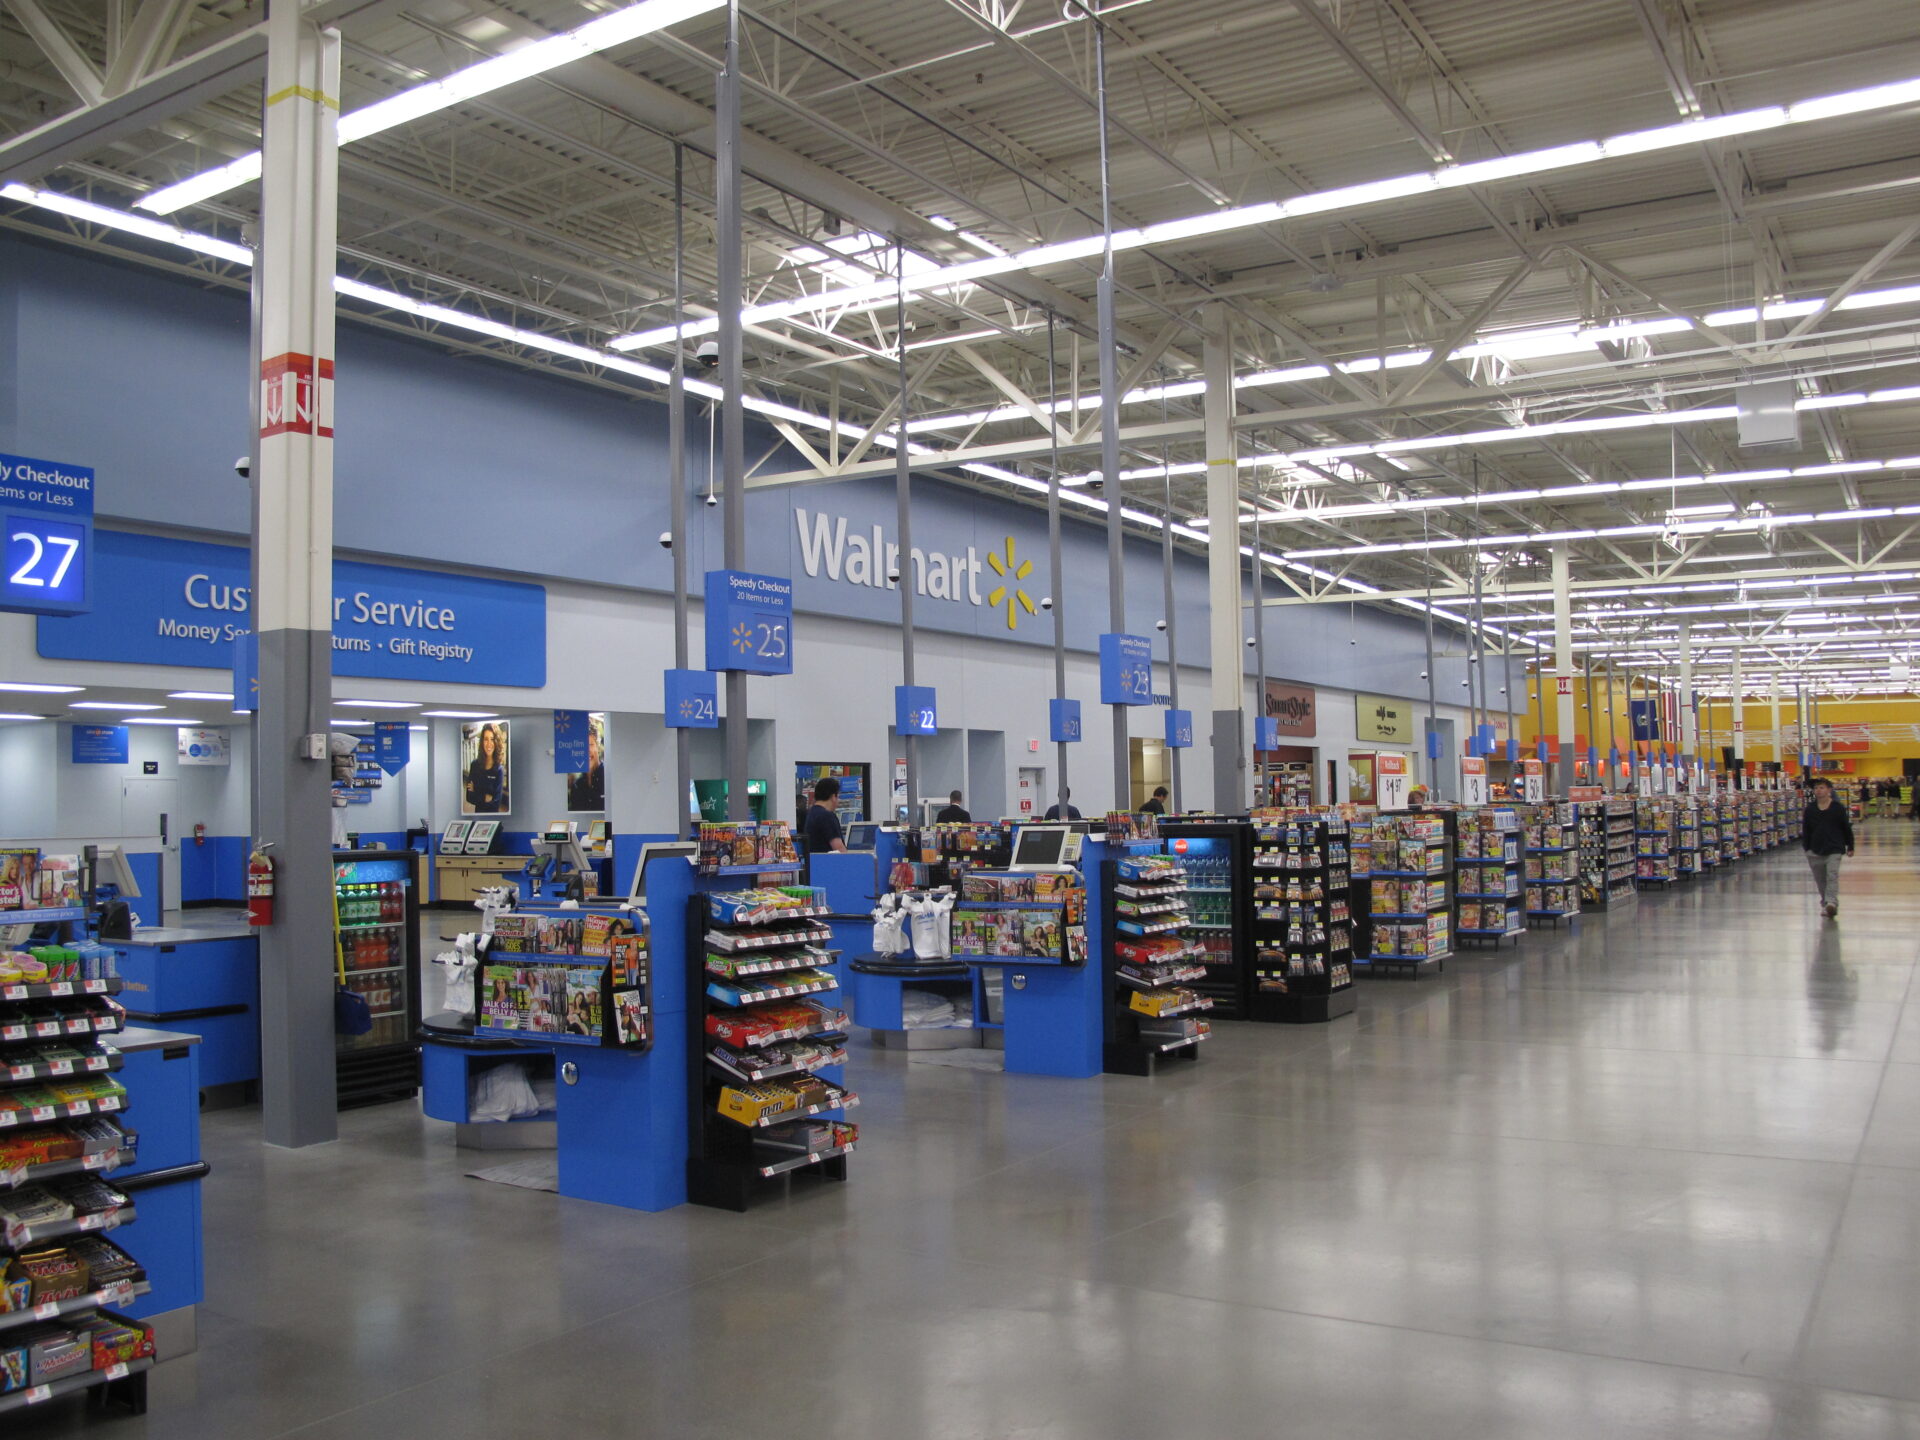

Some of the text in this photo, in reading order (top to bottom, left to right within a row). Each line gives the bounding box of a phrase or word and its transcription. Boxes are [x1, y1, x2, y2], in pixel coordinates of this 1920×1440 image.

[15, 465, 90, 490] Checkout
[28, 491, 43, 502] or
[46, 490, 74, 506] Less
[10, 532, 80, 588] 27
[796, 508, 981, 606] Walmart
[729, 575, 791, 594] Speedy Checkout
[737, 591, 745, 600] 20
[746, 593, 763, 603] Items
[771, 596, 784, 606] Less
[352, 592, 455, 631] Service
[158, 618, 220, 644] Money
[757, 623, 786, 658] 25
[389, 638, 416, 656] Gift
[419, 640, 473, 663] Registry
[1133, 669, 1149, 695] 23
[694, 698, 714, 720] 24
[920, 710, 935, 728] 22
[1071, 720, 1079, 736] 21
[1183, 728, 1191, 742] 20
[558, 740, 585, 750] Drop film
[571, 749, 585, 757] here
[501, 1001, 514, 1009] OFF
